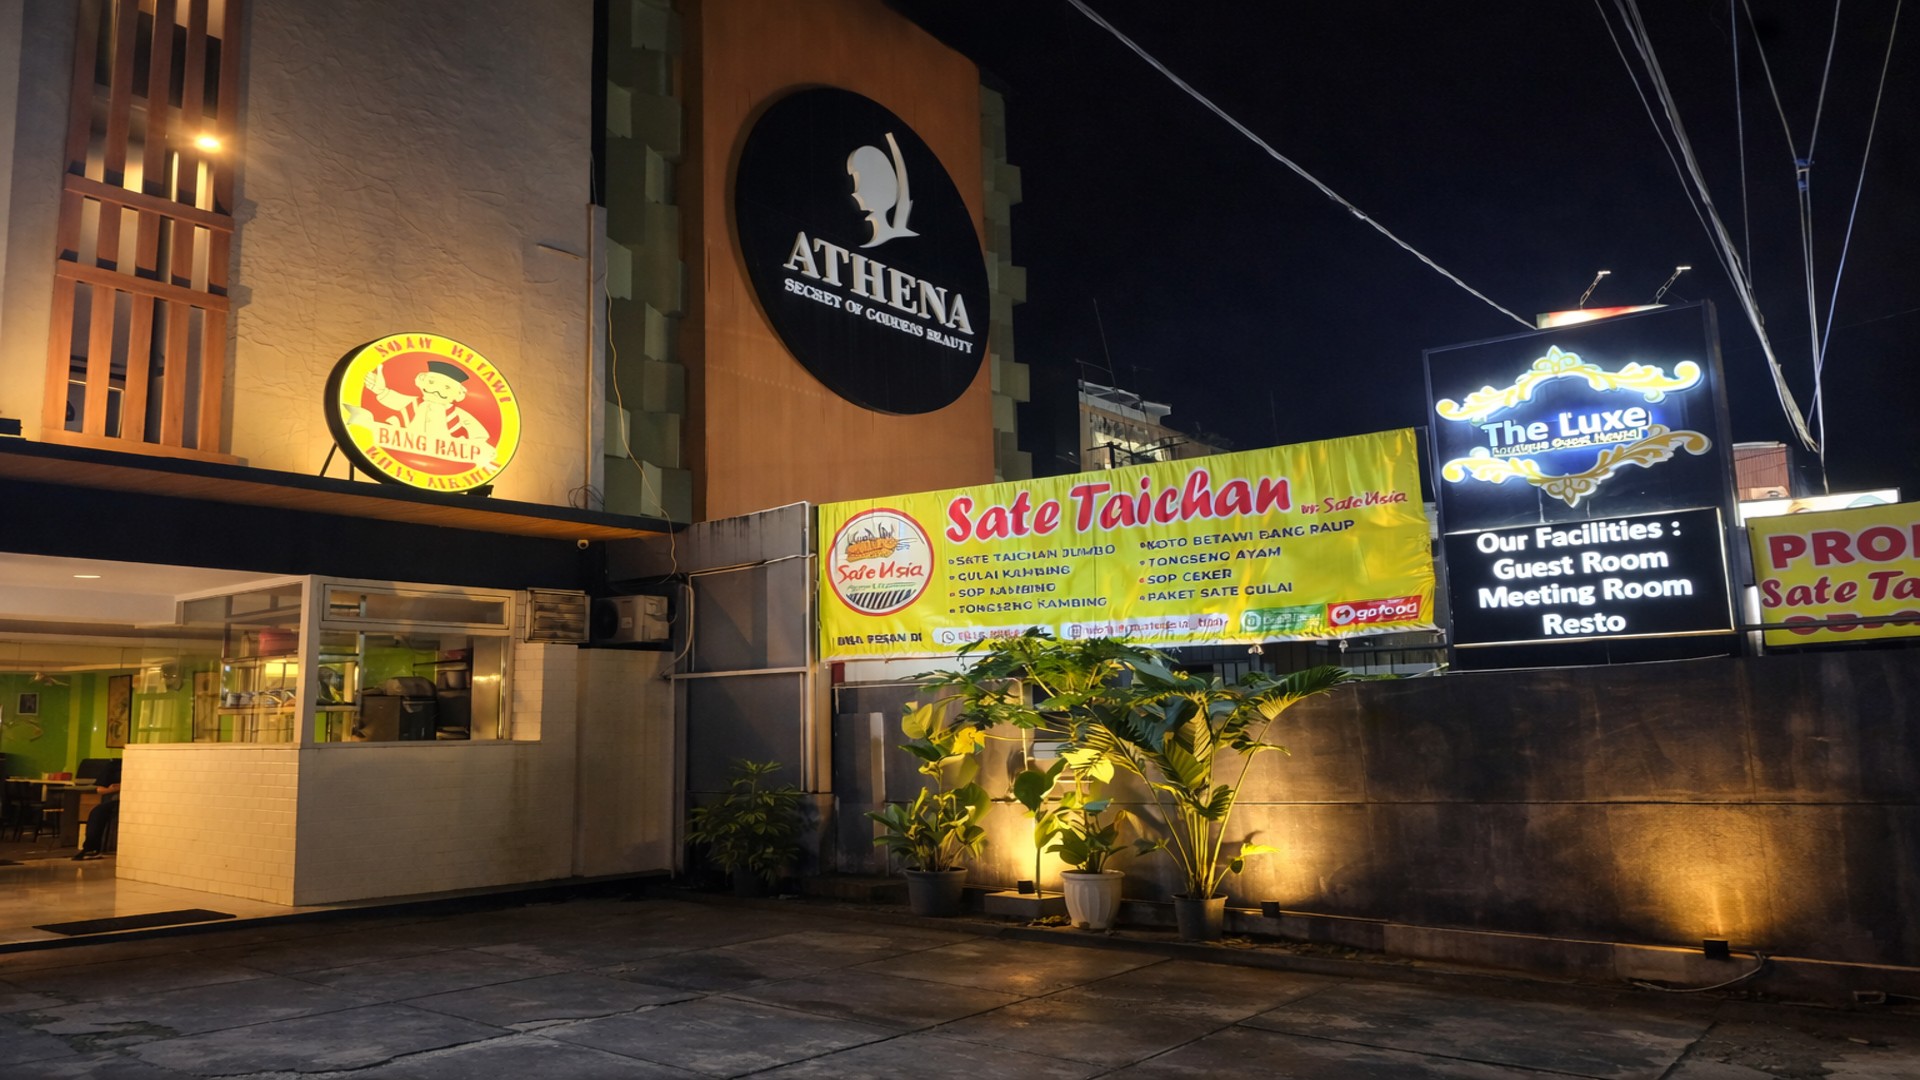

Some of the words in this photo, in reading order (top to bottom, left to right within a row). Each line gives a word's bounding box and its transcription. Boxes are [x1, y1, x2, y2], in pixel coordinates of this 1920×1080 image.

[782, 230, 975, 335] ATHENA
[378, 427, 427, 452] BANG
[1480, 418, 1549, 448] The
[1558, 405, 1649, 437] Luxe
[945, 490, 1060, 543] Sate
[1069, 467, 1293, 534] Taichan
[1192, 531, 1254, 546] BETAWI
[1309, 519, 1355, 535] RAUP
[1476, 531, 1528, 554] Our
[1535, 520, 1664, 549] Facilities
[1768, 523, 1920, 570] PRO
[1235, 546, 1281, 560] AYAM
[1492, 555, 1575, 580] Guest
[1581, 550, 1669, 574] Room
[1147, 573, 1177, 584] SOP
[1182, 568, 1233, 582] CEKER
[958, 588, 986, 598] SOP
[1037, 596, 1108, 609] KAMBING
[1148, 589, 1196, 601] PAKET
[1199, 585, 1240, 598] SATE
[1477, 583, 1597, 608] Meeting
[1602, 577, 1694, 600] Room
[1761, 575, 1858, 608] Sate
[1542, 611, 1627, 635] Resto
